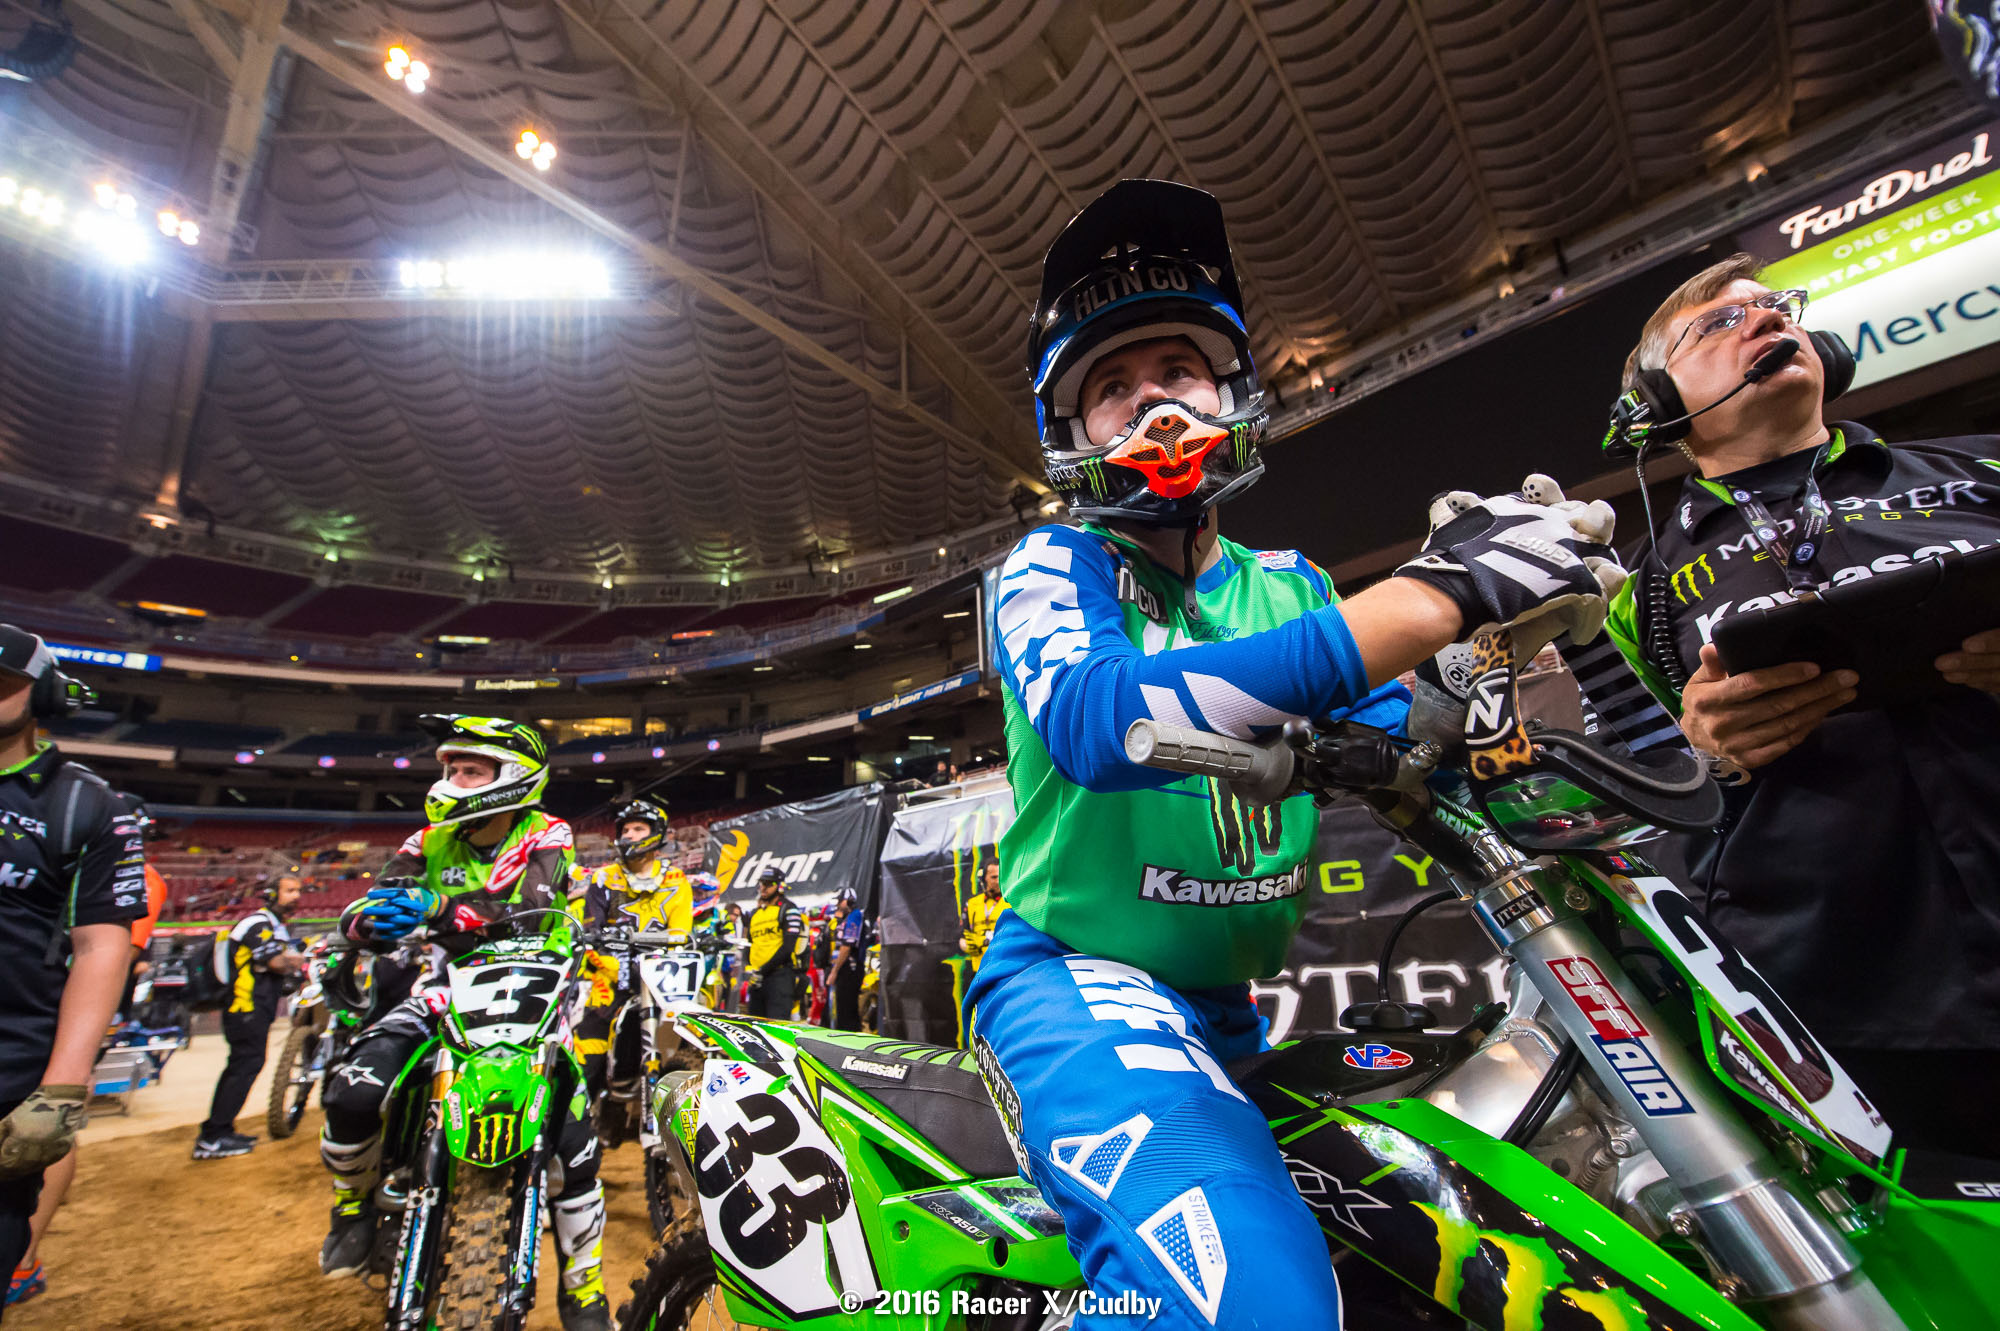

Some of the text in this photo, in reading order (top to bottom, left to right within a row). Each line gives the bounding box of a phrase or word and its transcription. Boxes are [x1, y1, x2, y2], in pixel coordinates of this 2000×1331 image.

[1779, 132, 1993, 249] FanDuel
[1833, 191, 1983, 265] ONE-WEEK
[1150, 266, 1191, 291] CO
[1138, 585, 1160, 620] CO
[1216, 625, 1239, 639] 1997
[482, 787, 529, 804] MONSTER
[1142, 858, 1309, 903] Kawasaki
[458, 966, 561, 1030] 3
[655, 960, 698, 993] 21
[1552, 956, 1642, 1034] SFF
[1652, 889, 1834, 1104] 3
[724, 1062, 751, 1086] AMA
[841, 1055, 909, 1080] Kawasaki
[1345, 1044, 1392, 1069] VP
[1601, 1041, 1683, 1112] AIR
[974, 1042, 1021, 1132] MONSTER
[699, 1092, 850, 1270] 33
[1188, 1195, 1218, 1243] STRIKE
